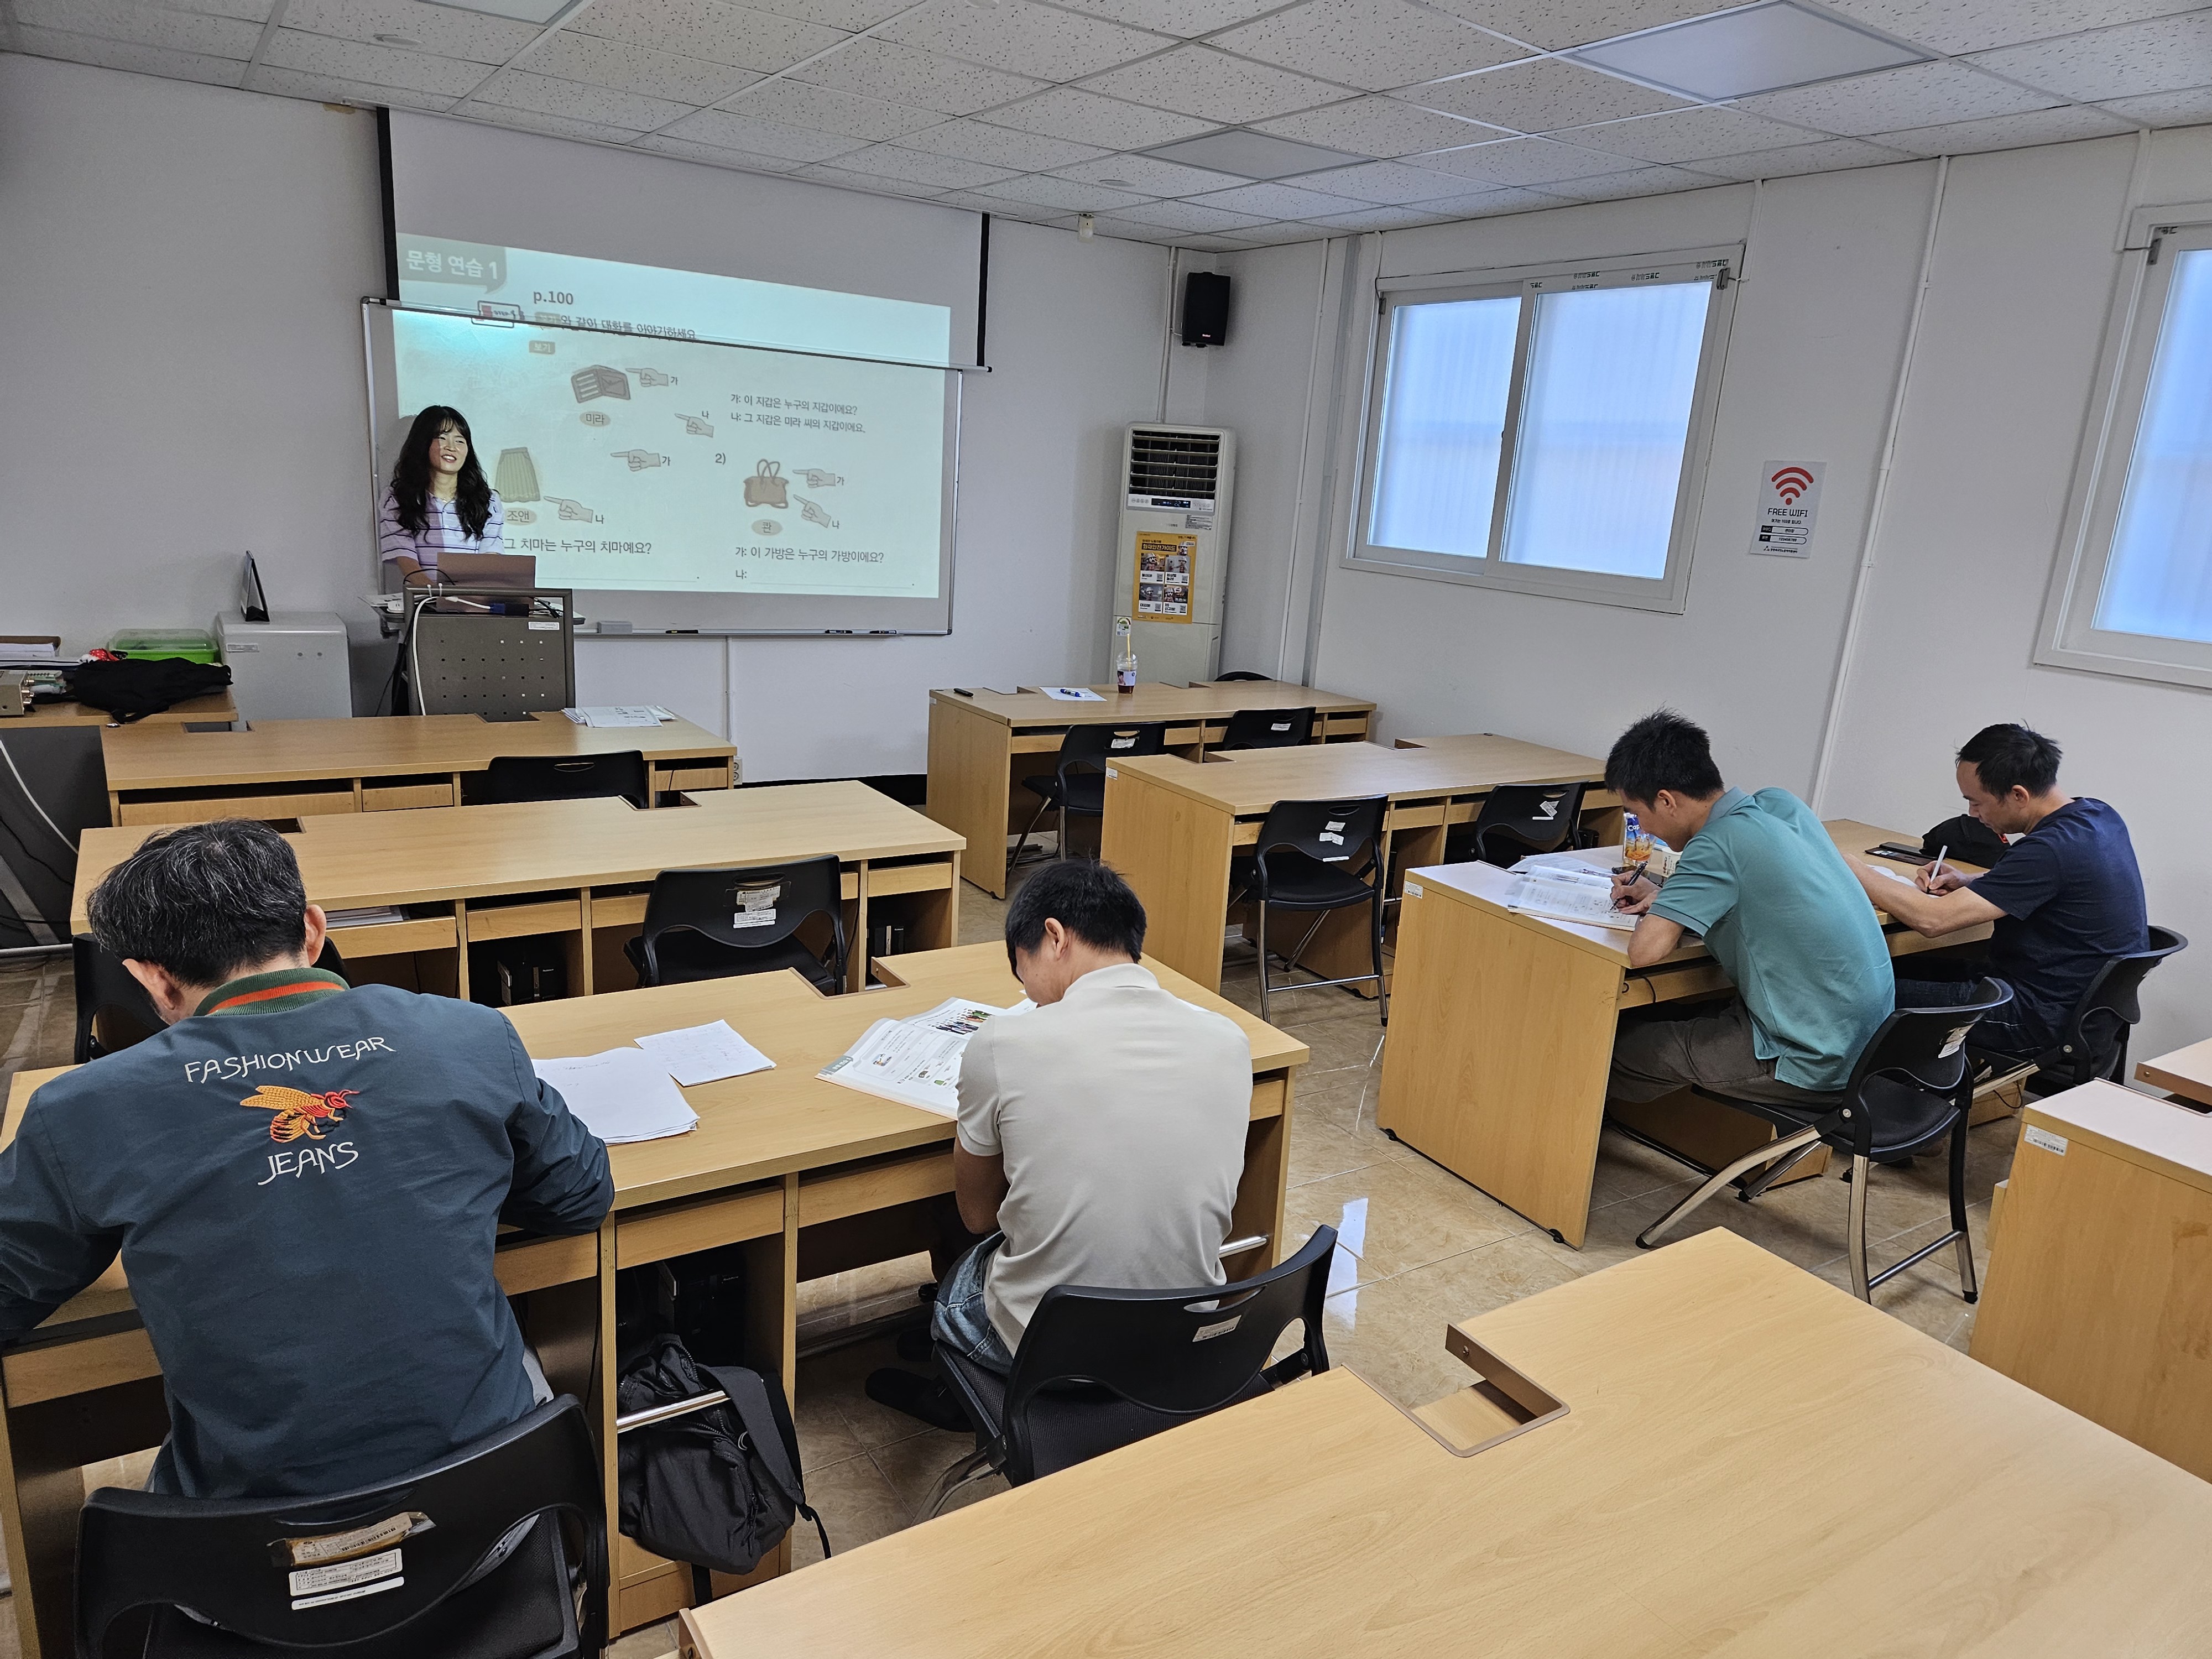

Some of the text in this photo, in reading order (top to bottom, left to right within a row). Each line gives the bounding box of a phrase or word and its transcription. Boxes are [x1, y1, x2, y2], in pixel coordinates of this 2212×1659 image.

[406, 250, 498, 280] 문형 연습 1
[533, 290, 573, 305] p.100
[601, 320, 633, 332] 대화를
[534, 342, 551, 353] 보기
[670, 376, 679, 385] 가
[731, 394, 858, 415] 가: 이 지갑은 누구의 지갑이에요?
[586, 414, 605, 425] 미라
[701, 410, 709, 419] 나
[731, 413, 865, 433] 나: 그 지갑은 미라 씨의 지갑이에요.
[661, 456, 671, 466] 가
[715, 452, 726, 465] 2)
[836, 476, 844, 486] 가
[506, 510, 530, 523] 조앤
[1767, 508, 1808, 517] FREE WIFI
[595, 514, 604, 524] 나
[832, 520, 840, 529] 나
[504, 538, 652, 554] 그 치마는 누구의 치마예요?
[735, 546, 884, 563] 가: 이 가방은 누구의 가방이에요?
[735, 569, 747, 579] 나:
[184, 1037, 397, 1084] FASHIONWEAR
[257, 1142, 359, 1186] JEANS
